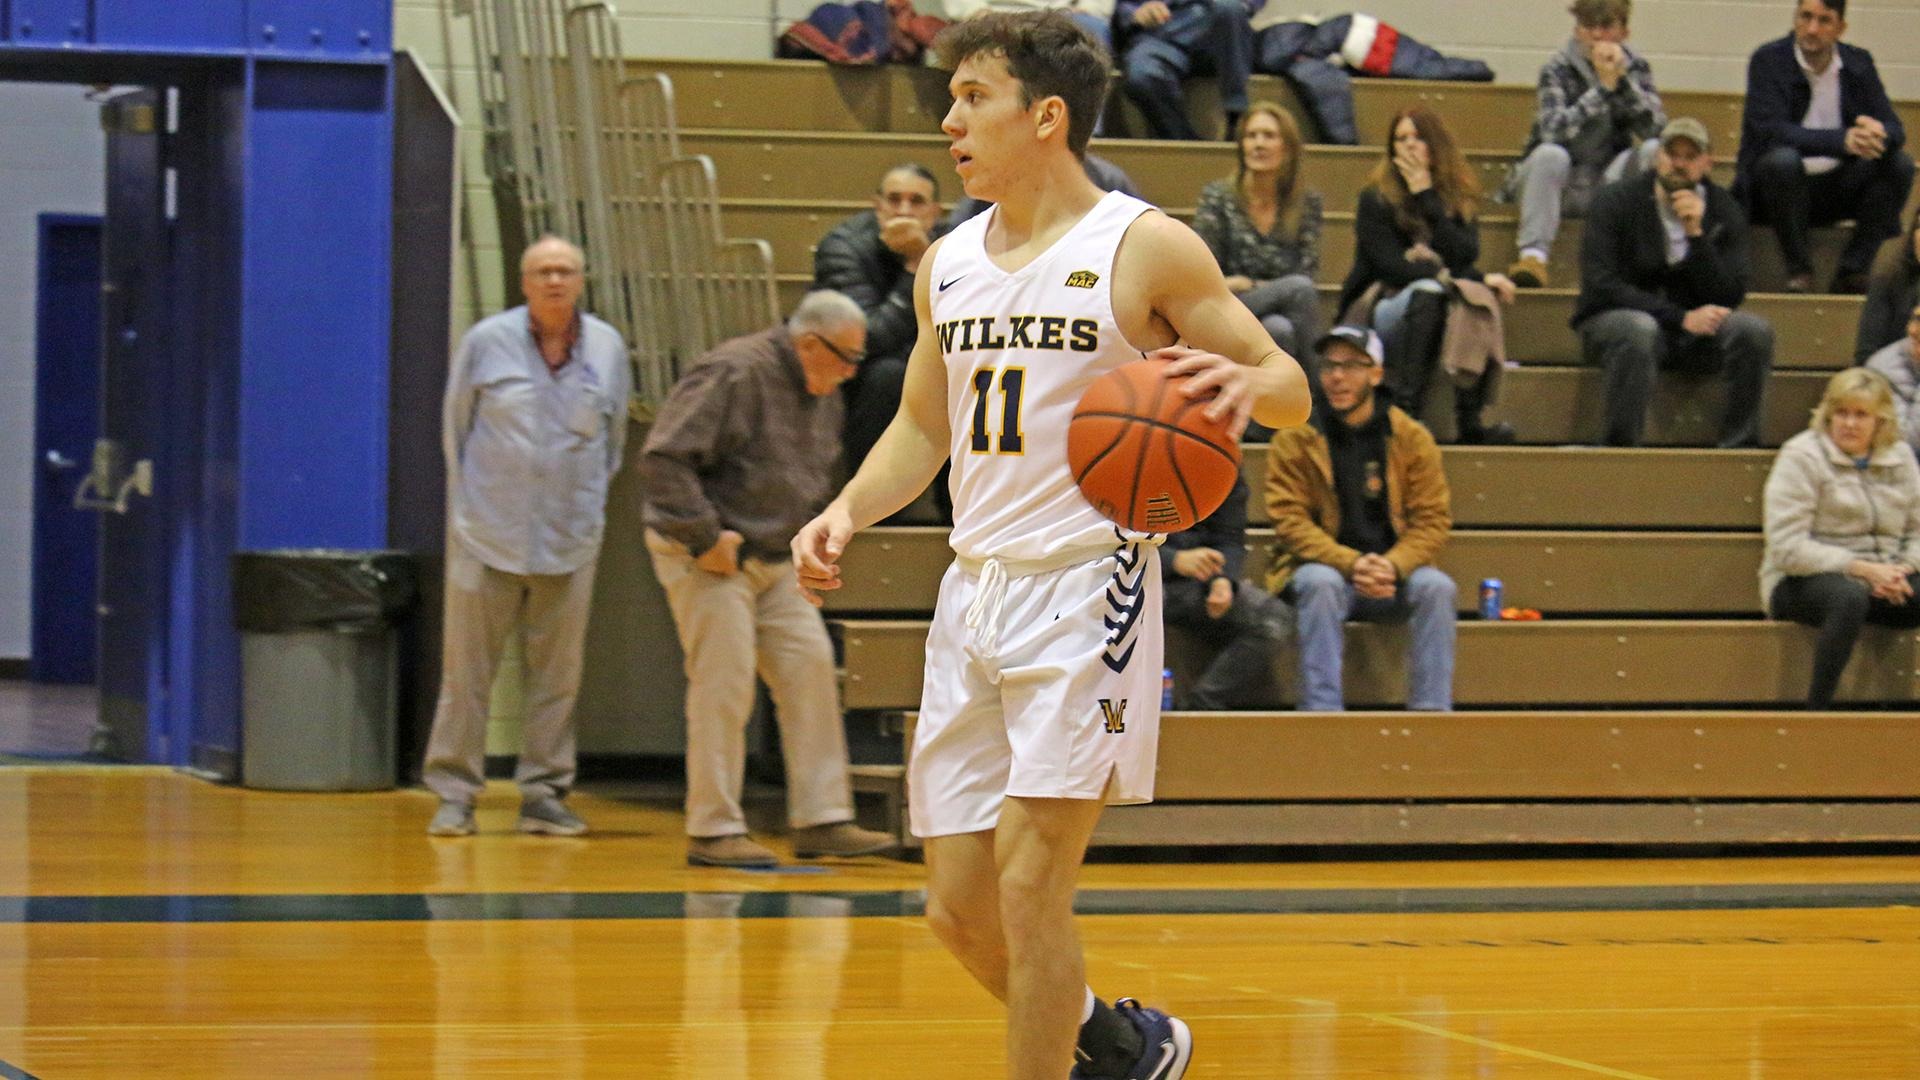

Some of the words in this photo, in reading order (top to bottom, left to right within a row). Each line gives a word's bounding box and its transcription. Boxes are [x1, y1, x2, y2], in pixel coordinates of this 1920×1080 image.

[1067, 277, 1097, 289] MAC
[935, 315, 1099, 355] WILKES
[970, 366, 1026, 456] 11
[1146, 492, 1182, 529] THE
